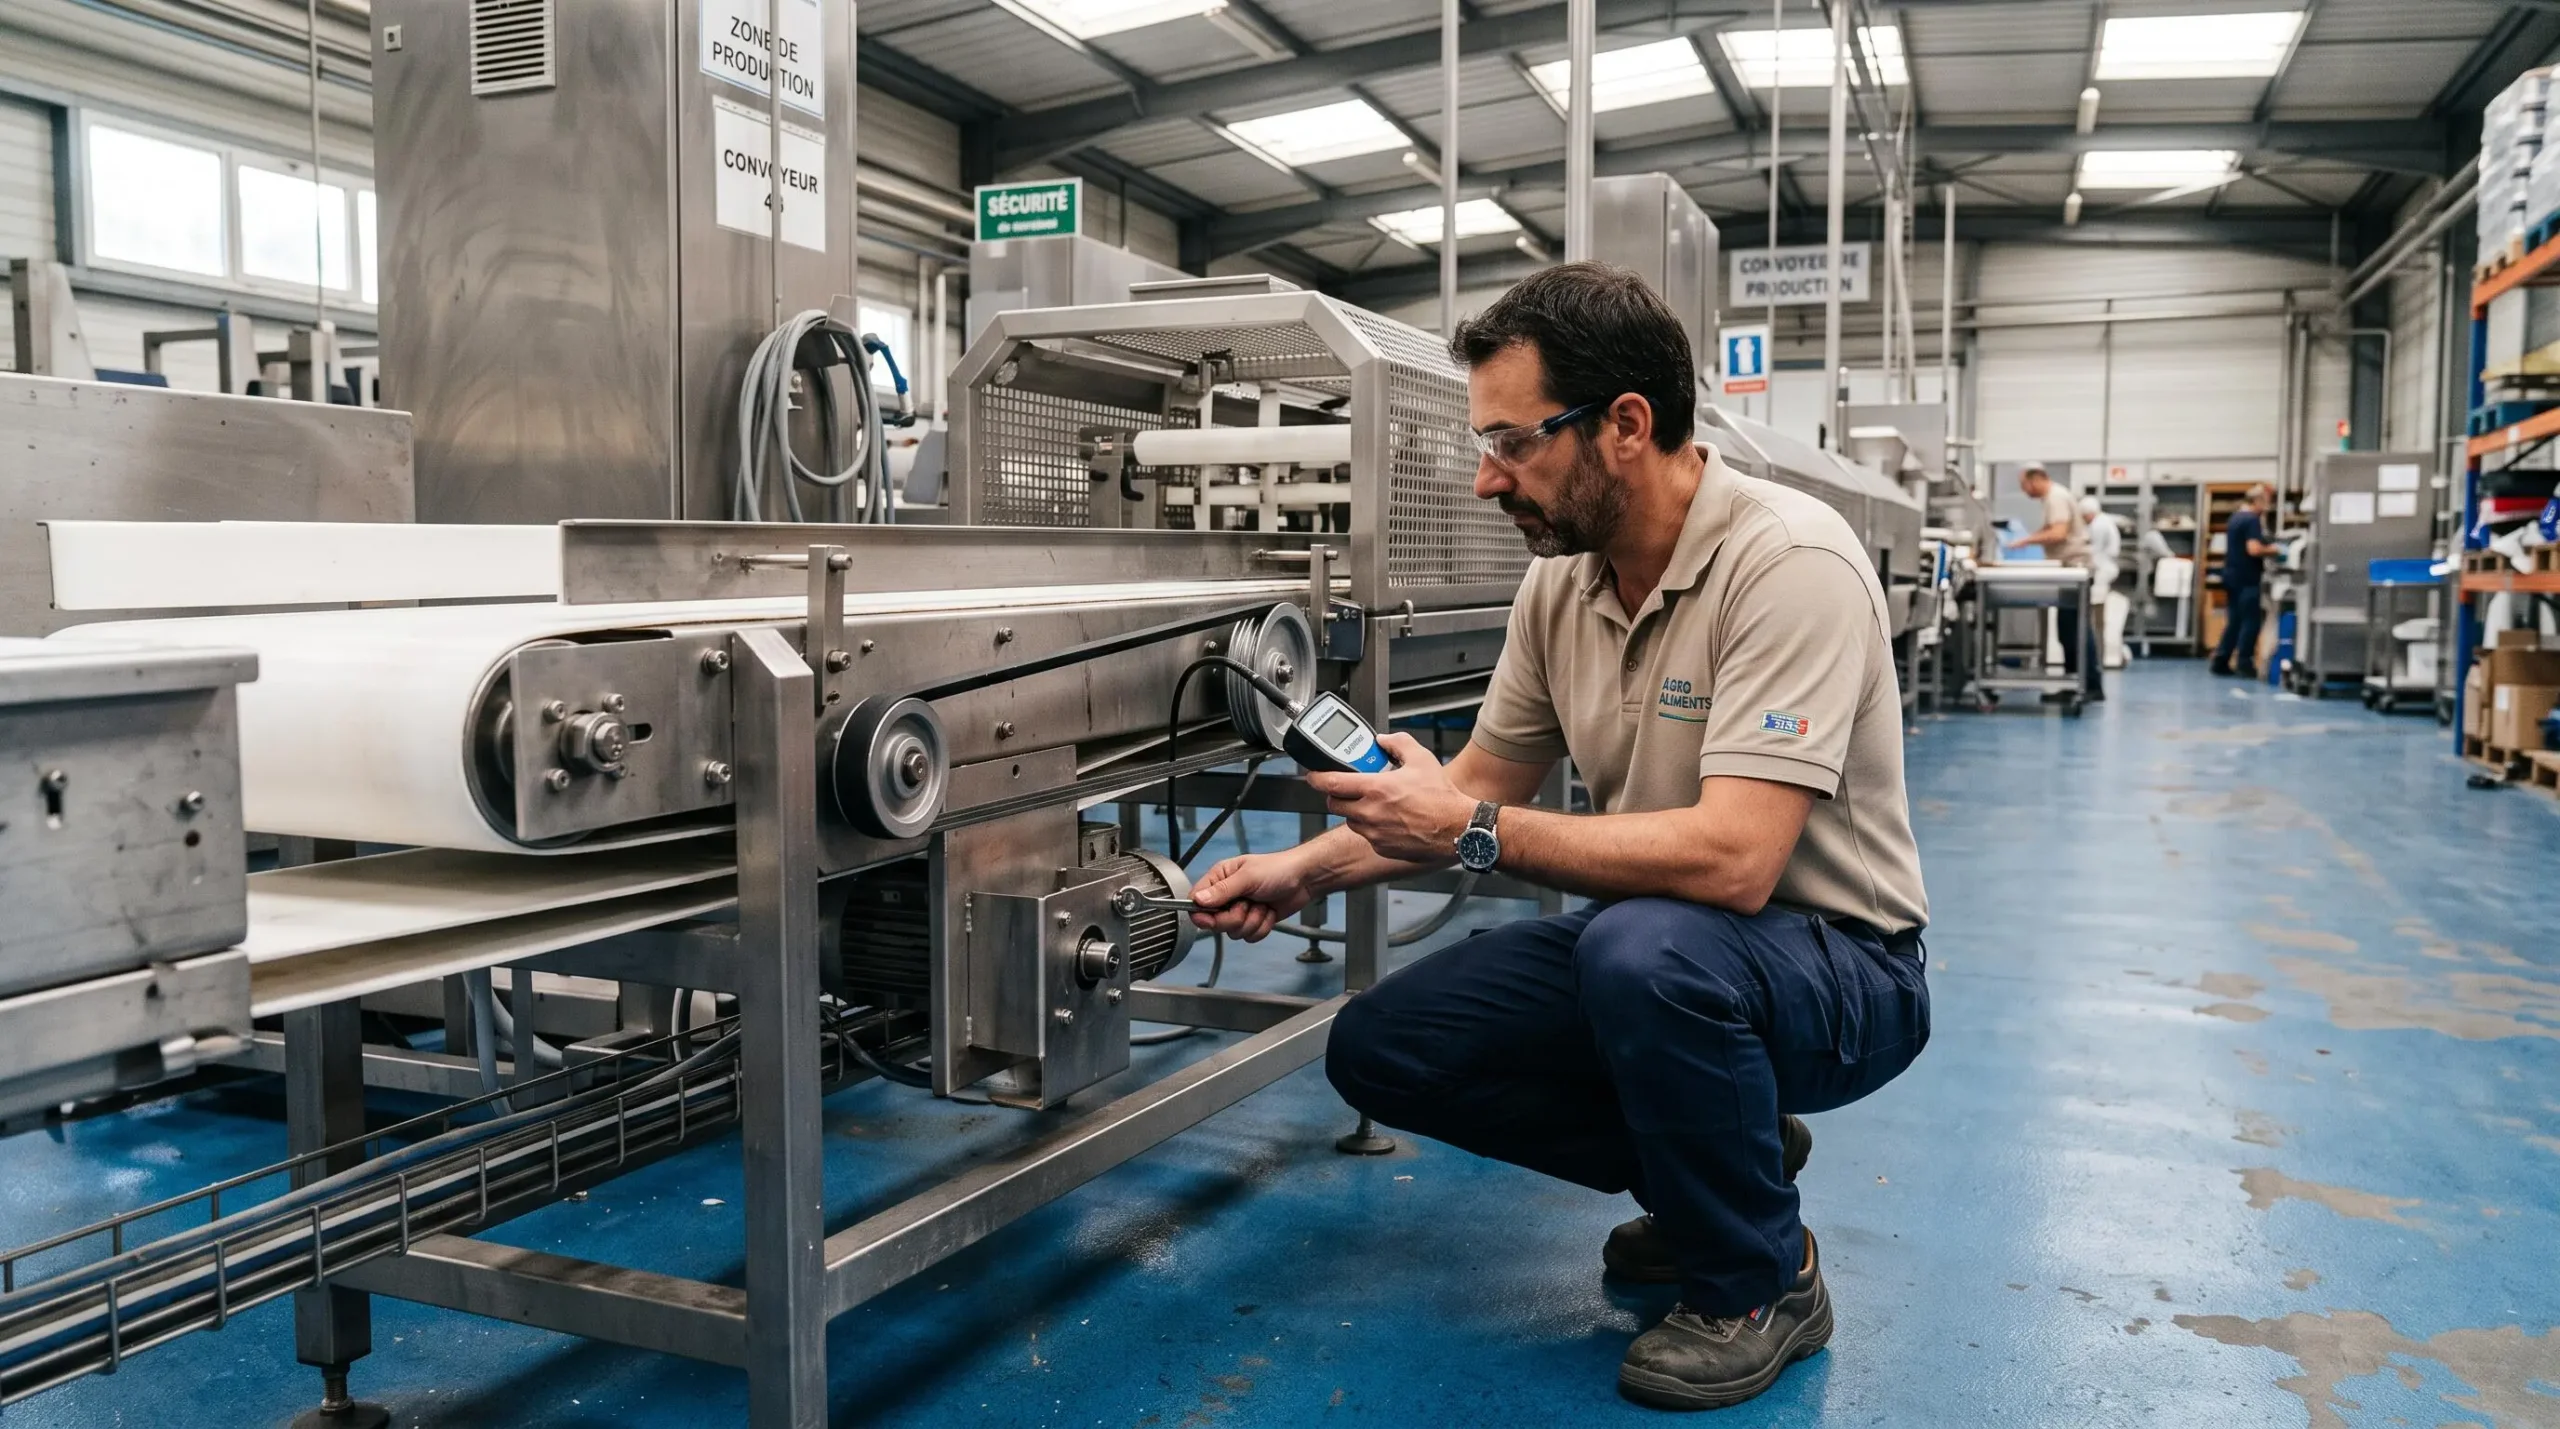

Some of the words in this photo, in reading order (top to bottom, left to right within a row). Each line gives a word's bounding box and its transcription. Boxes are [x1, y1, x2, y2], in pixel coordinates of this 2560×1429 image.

[730, 15, 771, 52] ZONE
[779, 37, 798, 63] DE
[712, 41, 815, 100] PRODUTION
[987, 185, 1069, 217] SÉCURITÉ
[1658, 691, 1713, 710] ALIMENTS
[1662, 676, 1691, 694] AGRO
